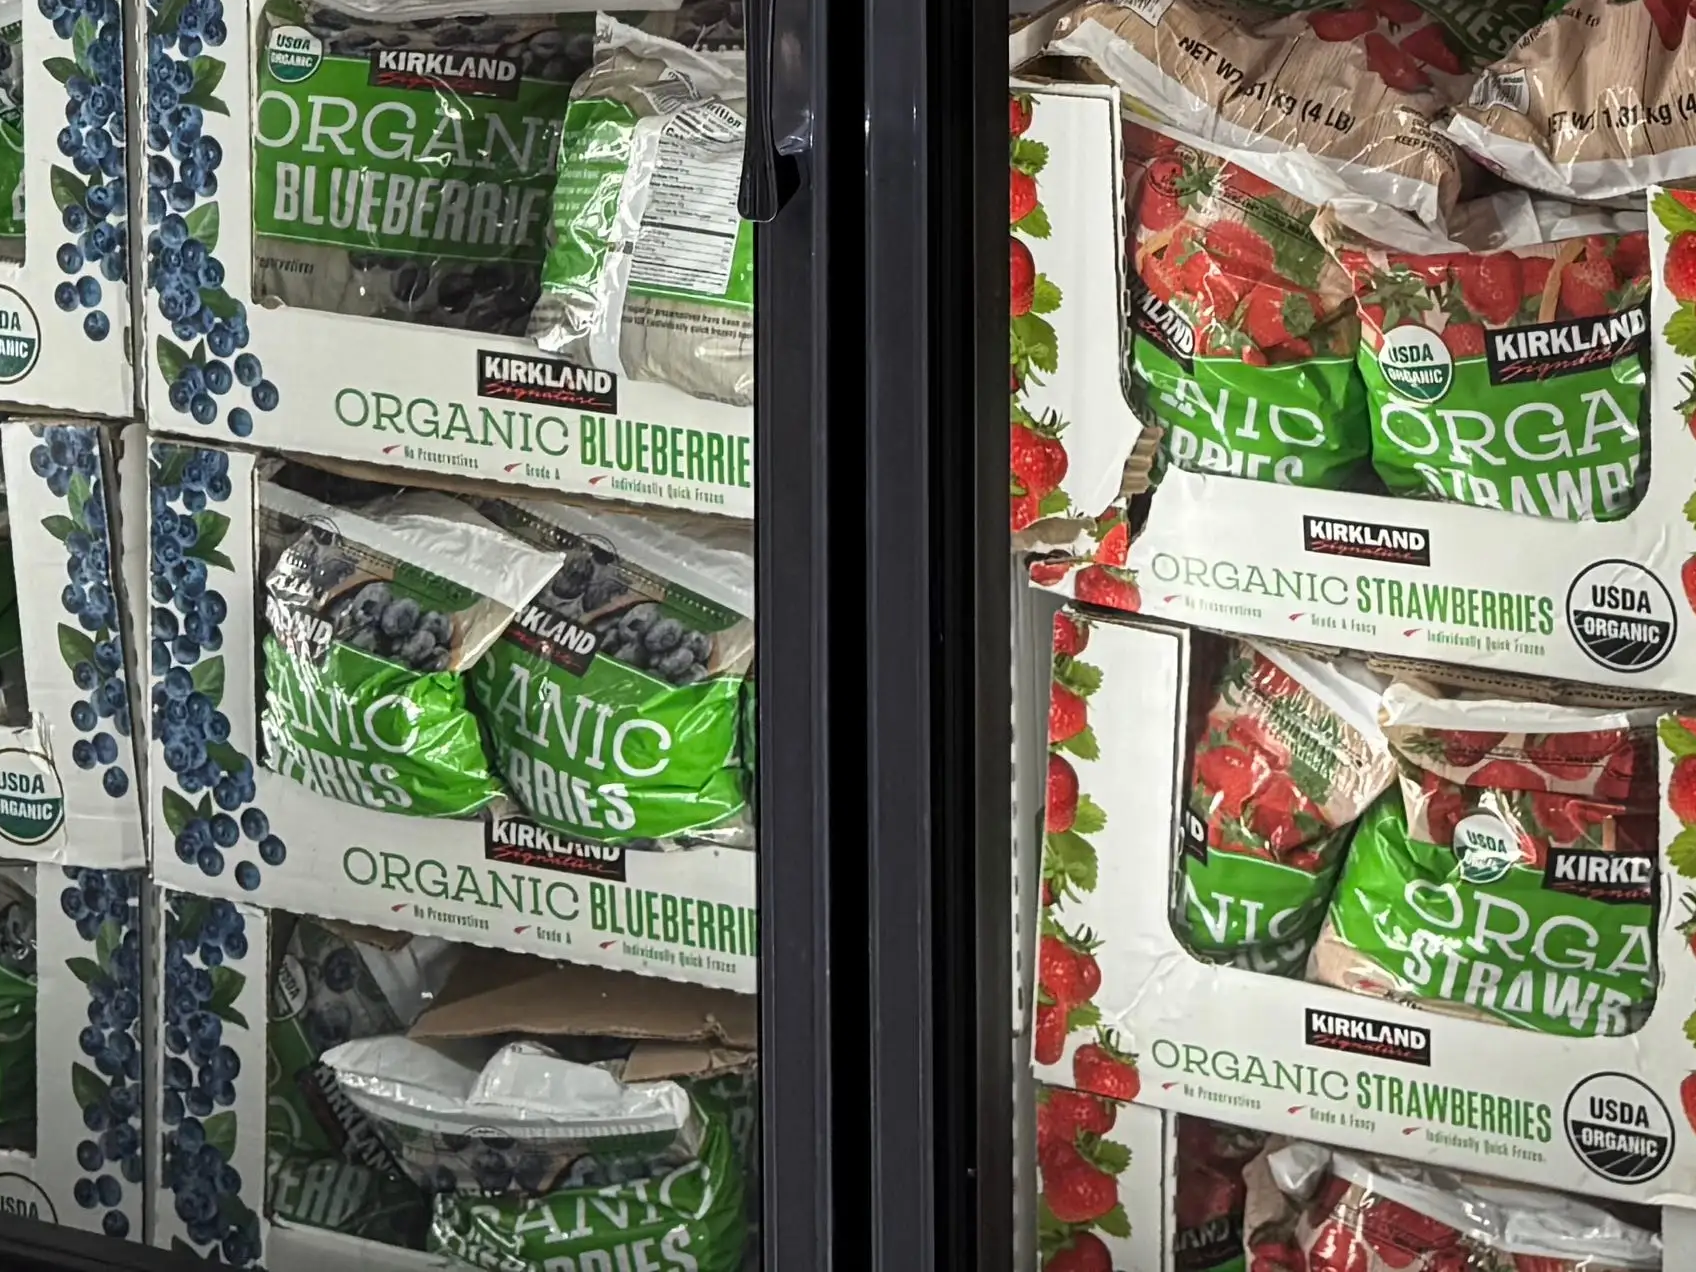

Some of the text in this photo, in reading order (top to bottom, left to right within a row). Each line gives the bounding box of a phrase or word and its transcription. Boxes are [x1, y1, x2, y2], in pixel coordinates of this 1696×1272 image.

[379, 50, 517, 83] KIRKLAND
[1644, 99, 1672, 128] kg
[485, 357, 612, 394] KIRKLAND
[1310, 520, 1425, 552] KIRKLAND
[1152, 552, 1554, 636] ORGANIC STRAWBERRIES
[1592, 586, 1652, 614] USDA
[1583, 616, 1661, 645] ORGANIC
[1152, 1038, 1552, 1144] ORGANIC STRAWBERRIES
[1589, 1096, 1650, 1129] USDA
[1581, 1128, 1658, 1158] ORGANIC
